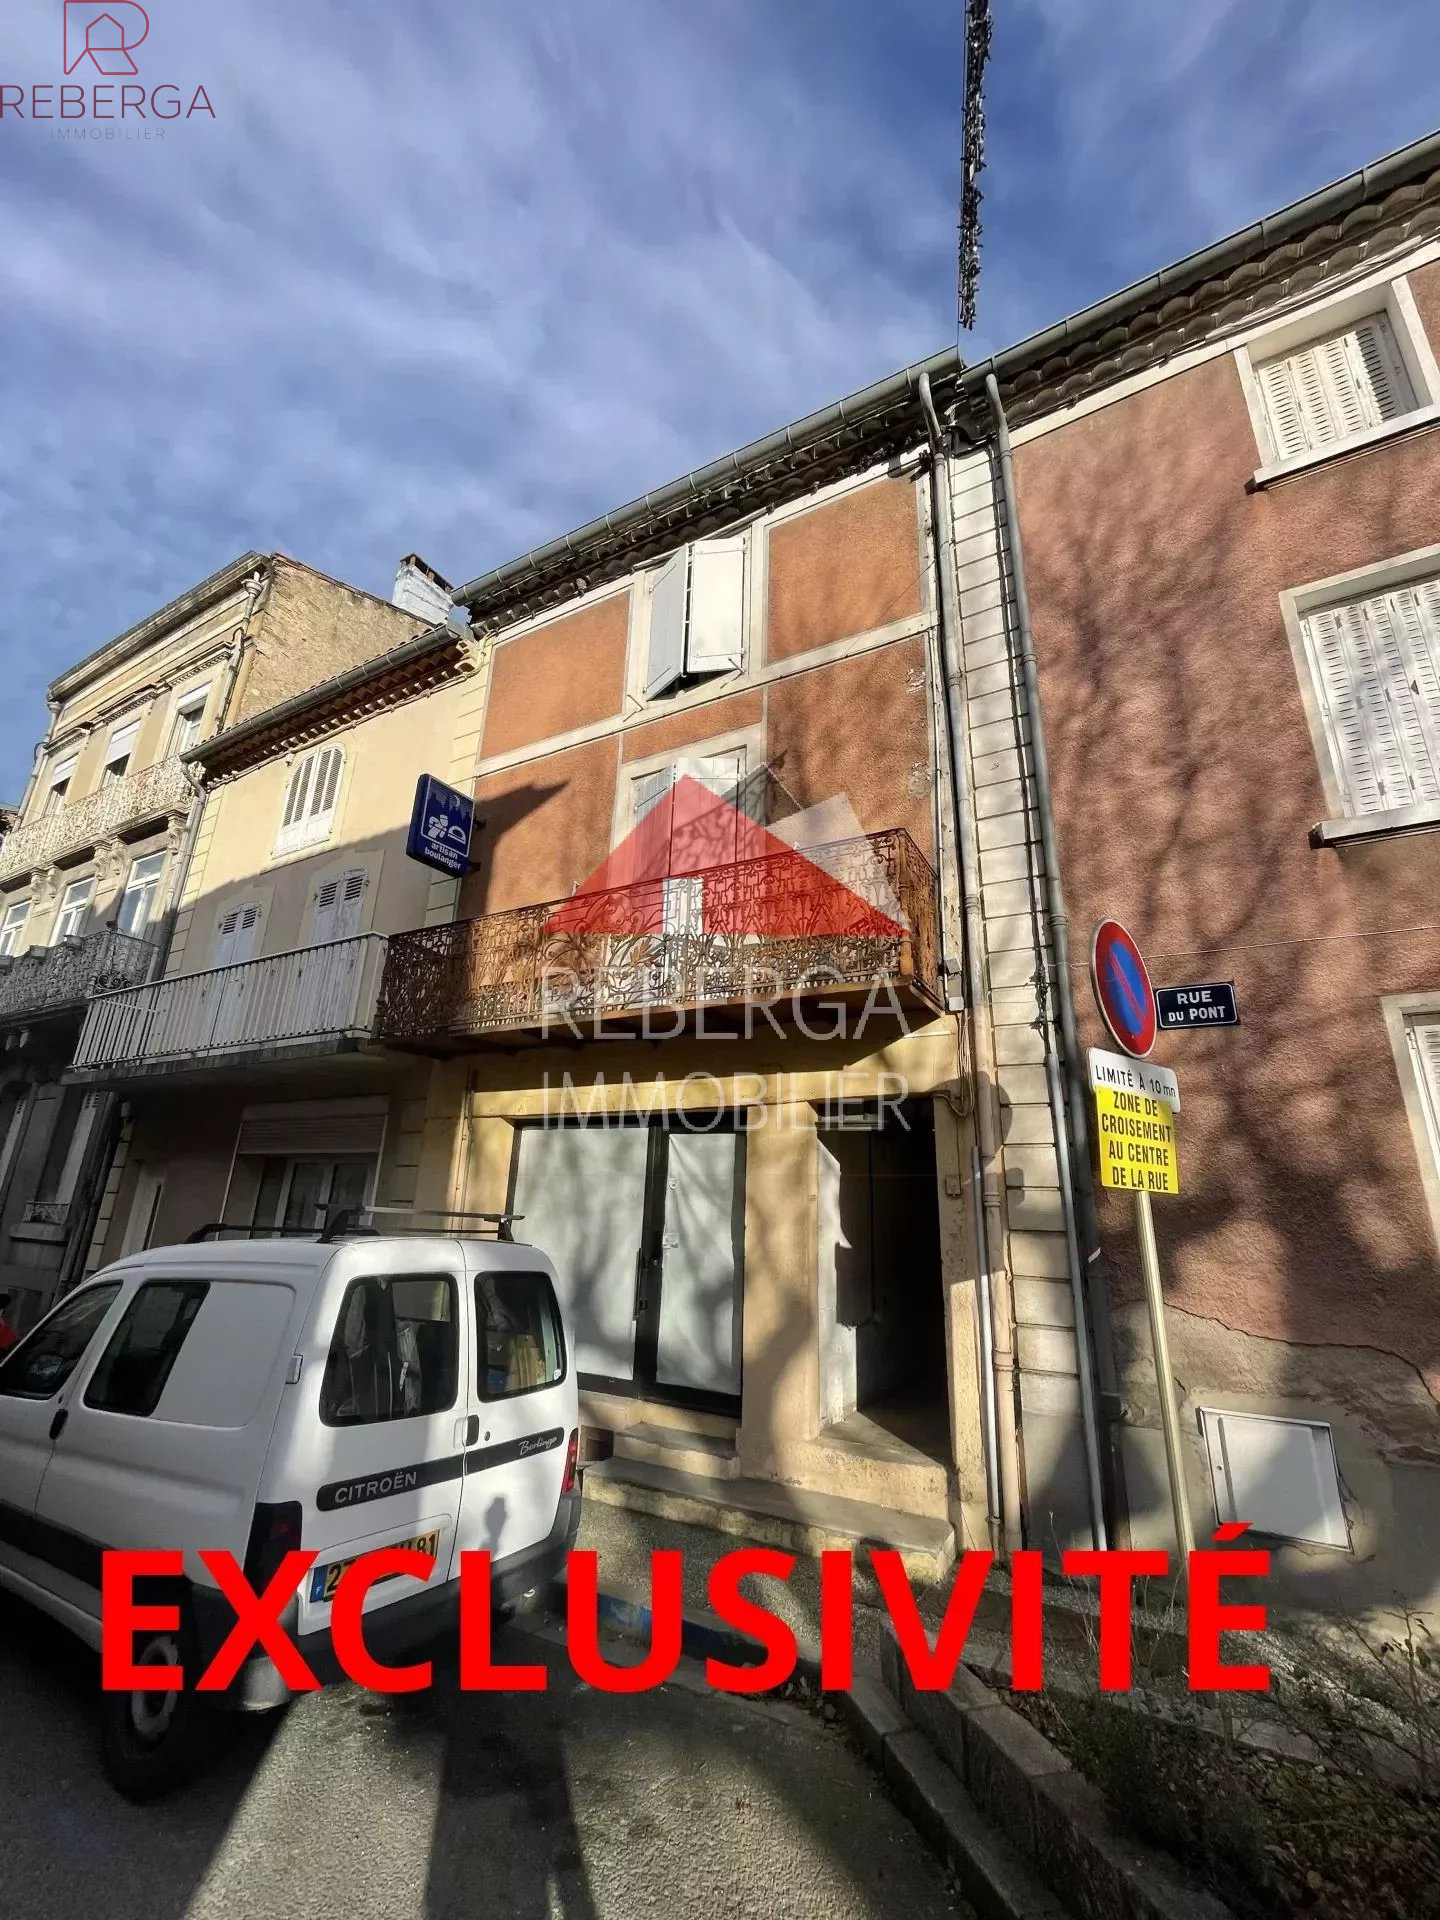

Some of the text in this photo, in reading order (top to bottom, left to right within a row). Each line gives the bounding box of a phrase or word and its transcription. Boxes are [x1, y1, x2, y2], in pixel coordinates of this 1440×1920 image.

[425, 846, 461, 870] boulanger
[431, 842, 458, 860] artisan
[1176, 990, 1213, 1005] RUE
[1168, 1005, 1226, 1022] DU PONT
[1095, 1064, 1177, 1098] LIMITÉ À 10 mn
[1113, 1091, 1158, 1117] ZONE DE
[1101, 1113, 1172, 1143] CROISEMENT
[1108, 1140, 1169, 1167] AU CENTRE
[1112, 1166, 1169, 1191] DE LA RUE
[518, 1436, 558, 1456] Berlingo
[334, 1471, 417, 1504] CITROËN
